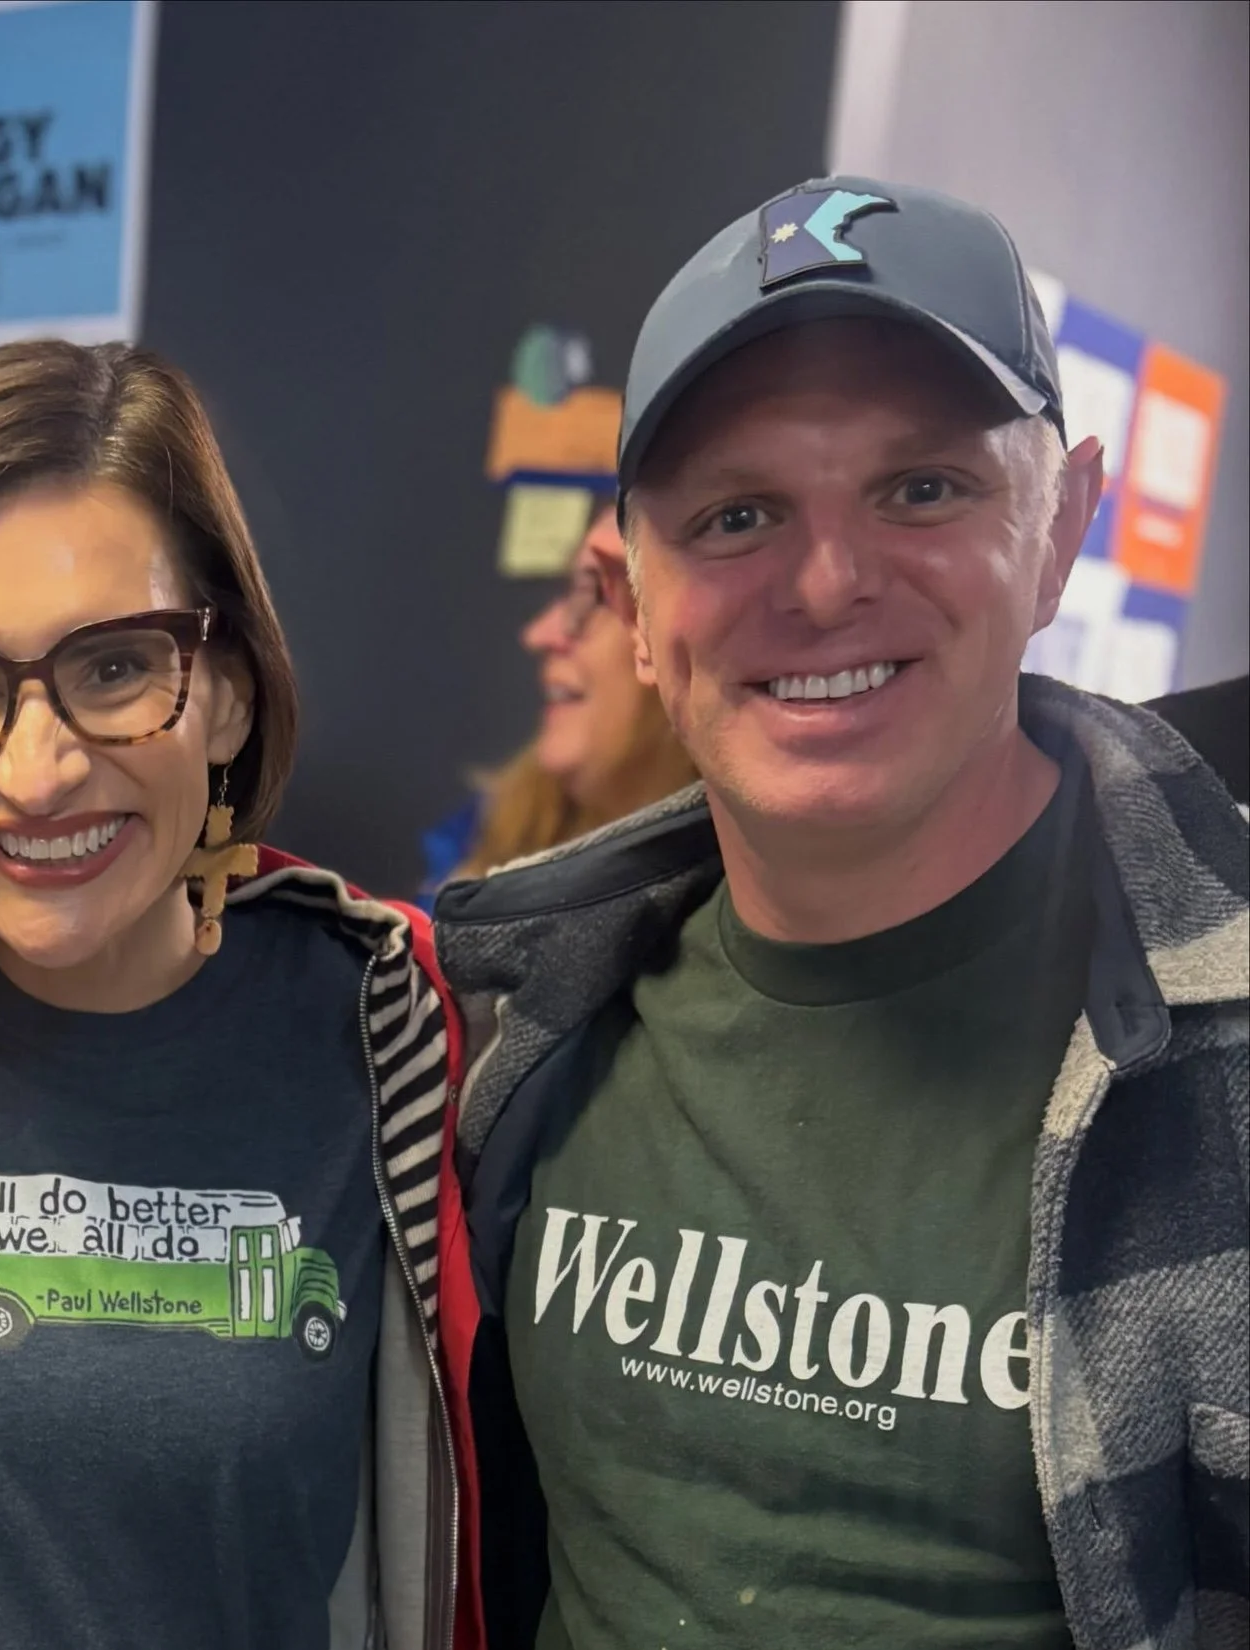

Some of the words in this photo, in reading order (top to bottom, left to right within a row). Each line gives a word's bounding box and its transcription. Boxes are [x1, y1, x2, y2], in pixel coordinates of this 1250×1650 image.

[40, 1178, 87, 1215] do
[108, 1186, 231, 1226] better
[83, 1219, 124, 1256] all
[151, 1229, 200, 1259] do
[99, 1290, 202, 1315] Wellstone
[534, 1208, 1030, 1409] Wellstone
[621, 1356, 897, 1431] www.wellstone.org
